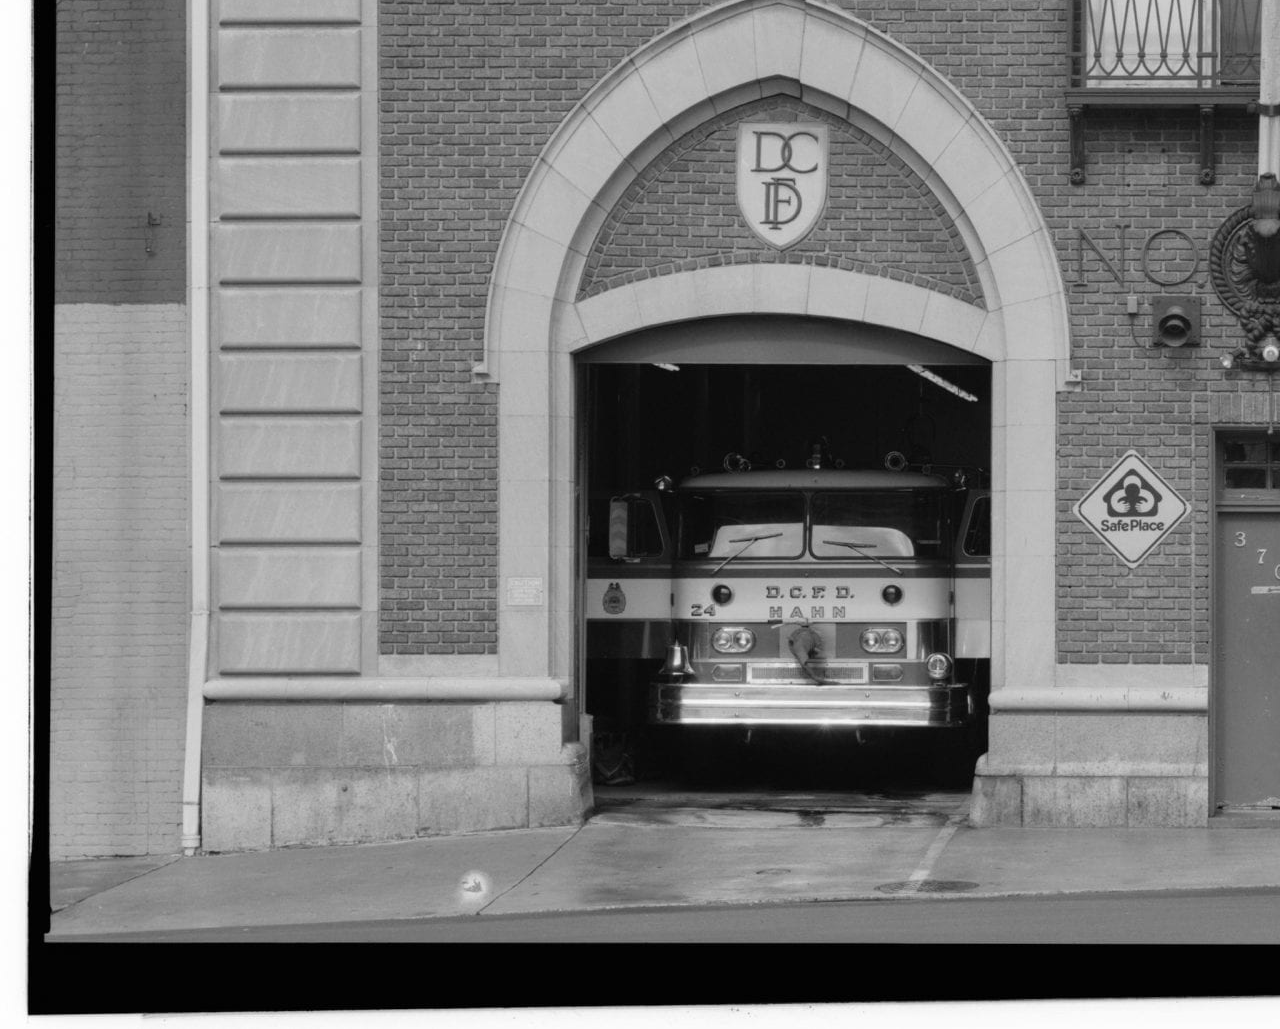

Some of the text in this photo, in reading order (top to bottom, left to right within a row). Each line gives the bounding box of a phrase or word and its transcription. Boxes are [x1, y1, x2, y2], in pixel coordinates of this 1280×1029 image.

[750, 131, 818, 174] DC
[691, 603, 717, 617] 24
[769, 606, 846, 619] HAHN
